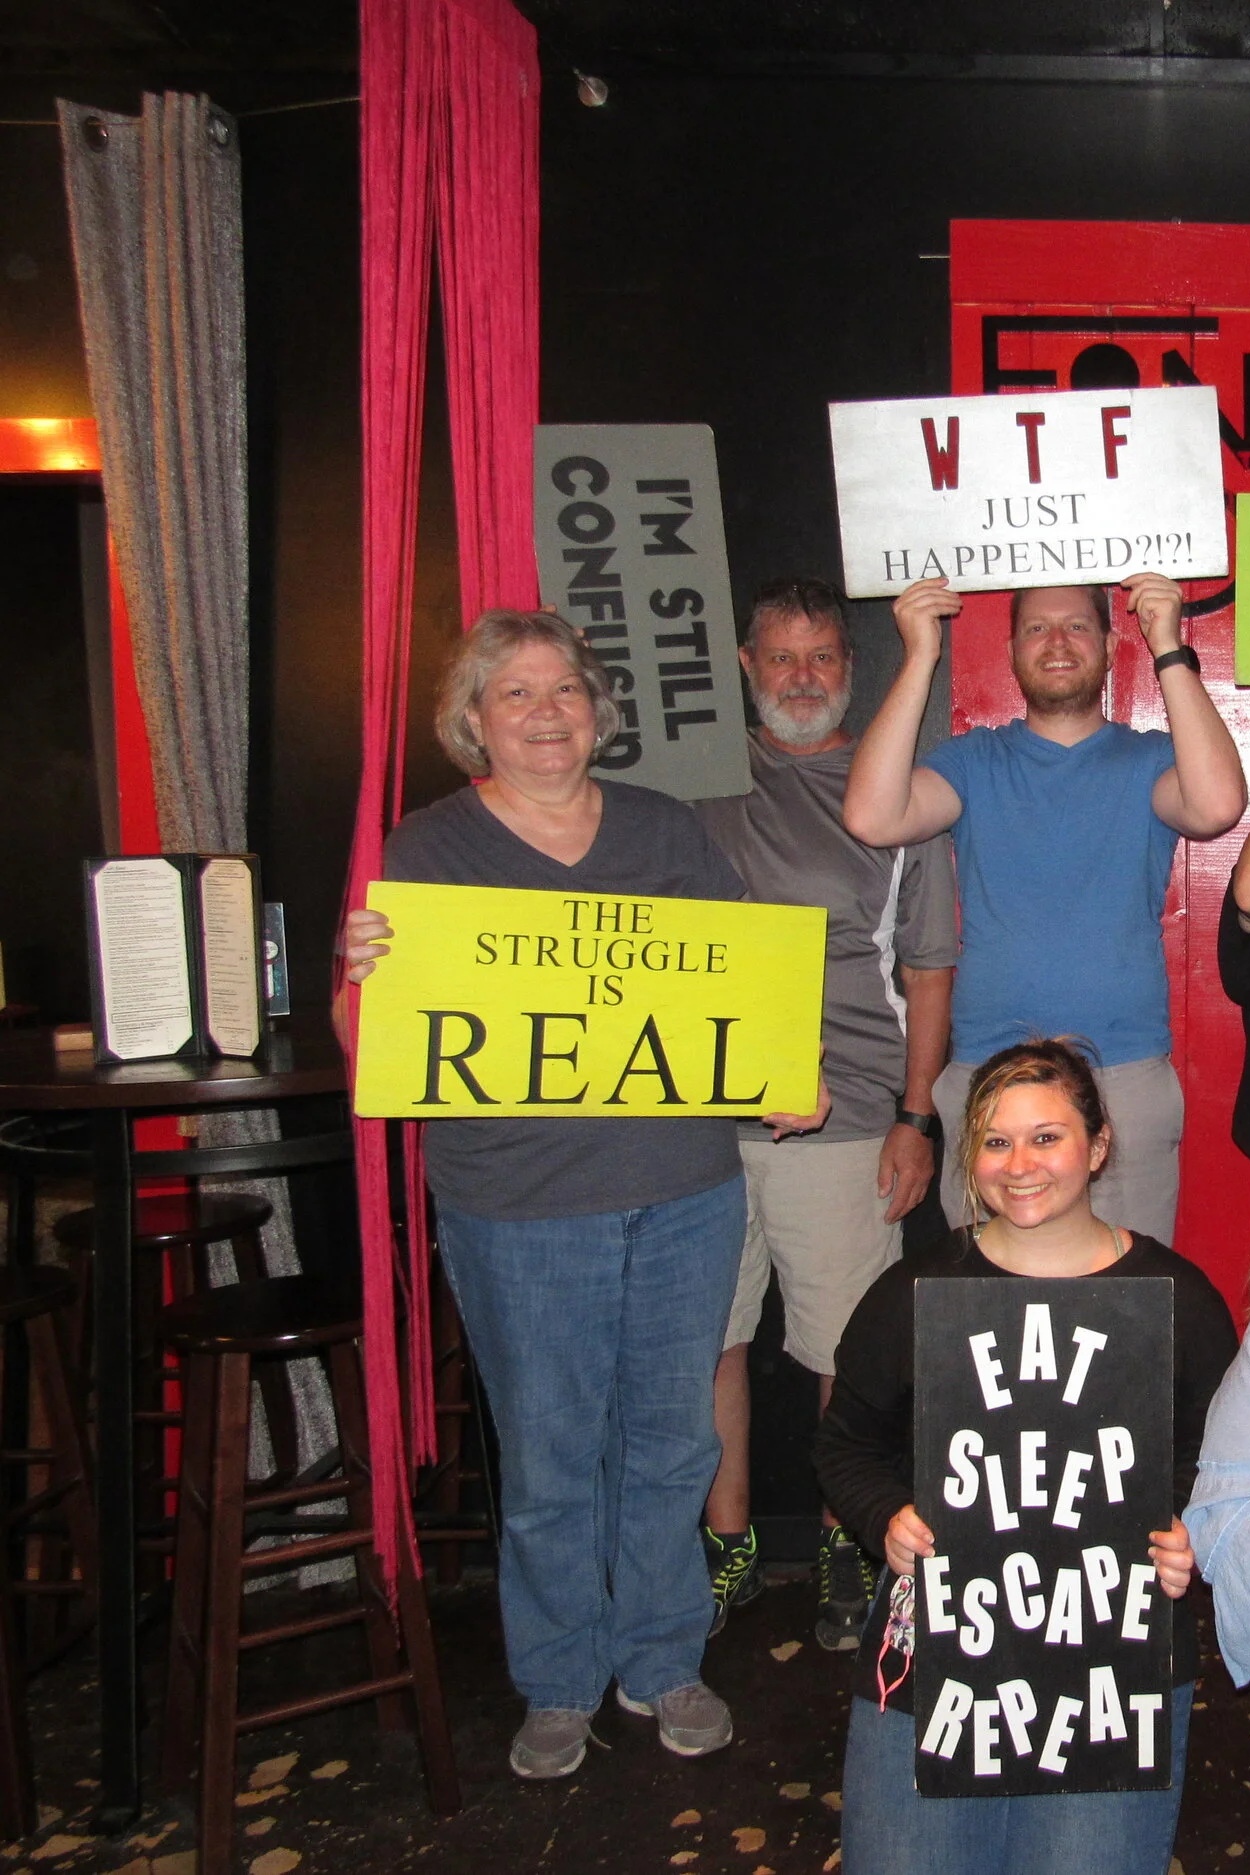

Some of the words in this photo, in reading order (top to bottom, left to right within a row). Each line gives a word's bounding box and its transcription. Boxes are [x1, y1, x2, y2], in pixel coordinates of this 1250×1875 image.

[636, 479, 695, 556] I'M
[982, 493, 1087, 531] JUST
[881, 532, 1194, 582] HAPPENED?!?!
[649, 588, 718, 741] STILL
[475, 932, 728, 974] STRUGGLE
[563, 900, 654, 934] THE
[585, 975, 624, 1006] IS
[411, 1009, 769, 1105] REAL
[968, 1303, 1108, 1411] EAT
[943, 1426, 1136, 1532] SLEEP
[923, 1545, 1157, 1657] ESCAPE
[920, 1665, 1163, 1776] REPEAT
